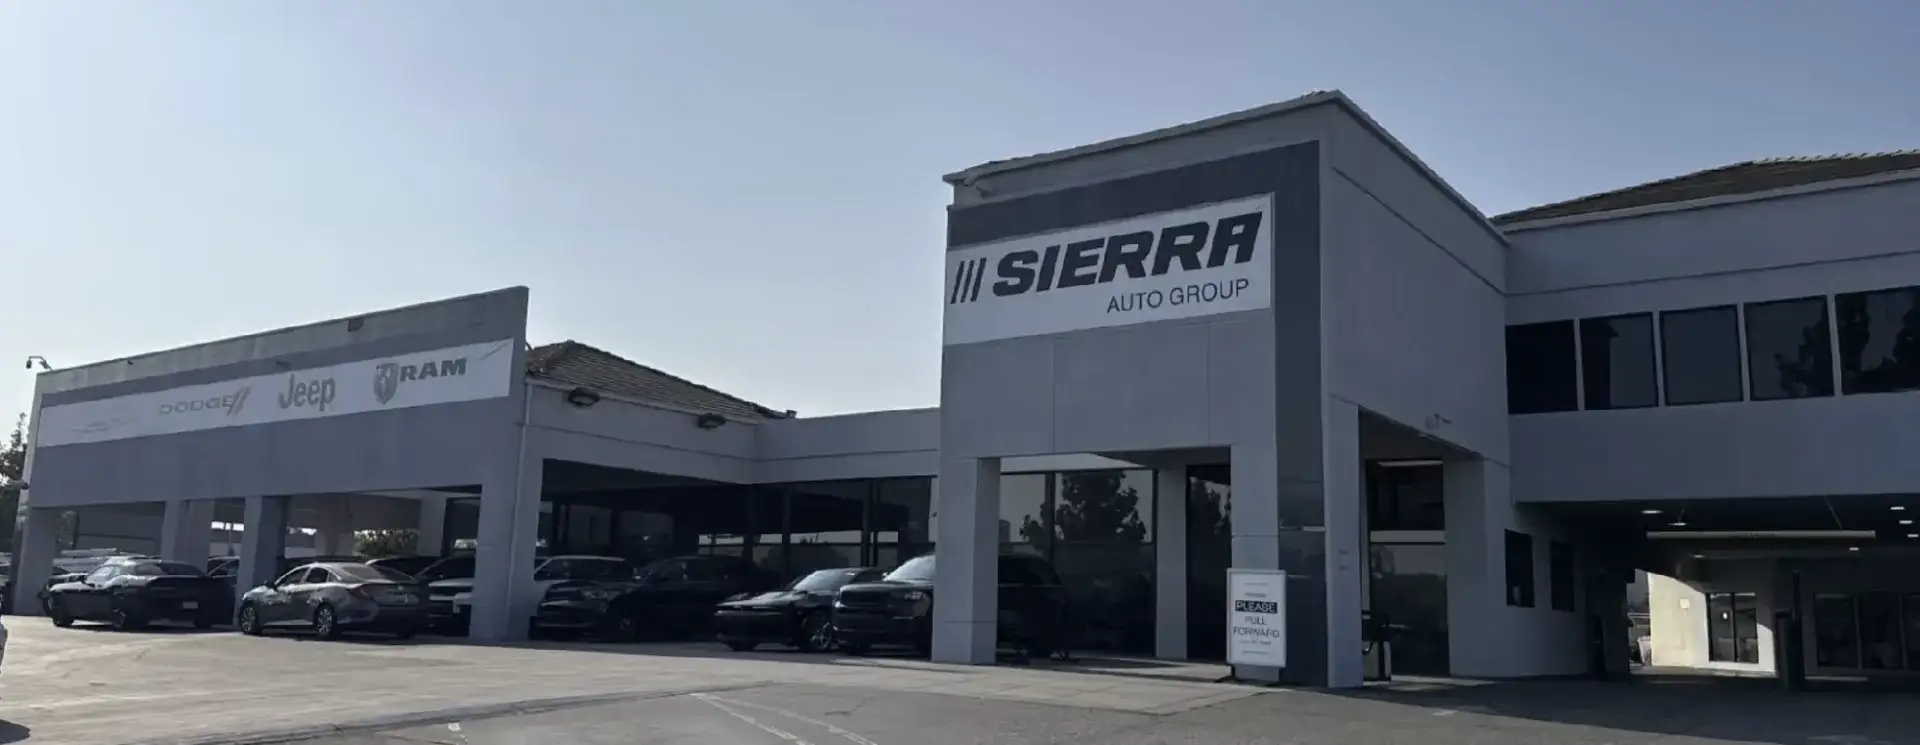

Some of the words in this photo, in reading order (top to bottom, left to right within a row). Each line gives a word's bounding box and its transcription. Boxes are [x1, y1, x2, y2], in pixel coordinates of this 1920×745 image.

[992, 211, 1263, 297] SIERRA
[1106, 290, 1163, 314] AUTO
[1169, 278, 1250, 305] GROUP
[400, 358, 467, 382] RAM
[278, 373, 336, 411] Jeep
[159, 395, 235, 415] DODGE
[1236, 601, 1276, 613] PLEASE
[1245, 616, 1267, 625] PULL
[1233, 627, 1280, 638] FORWARD
